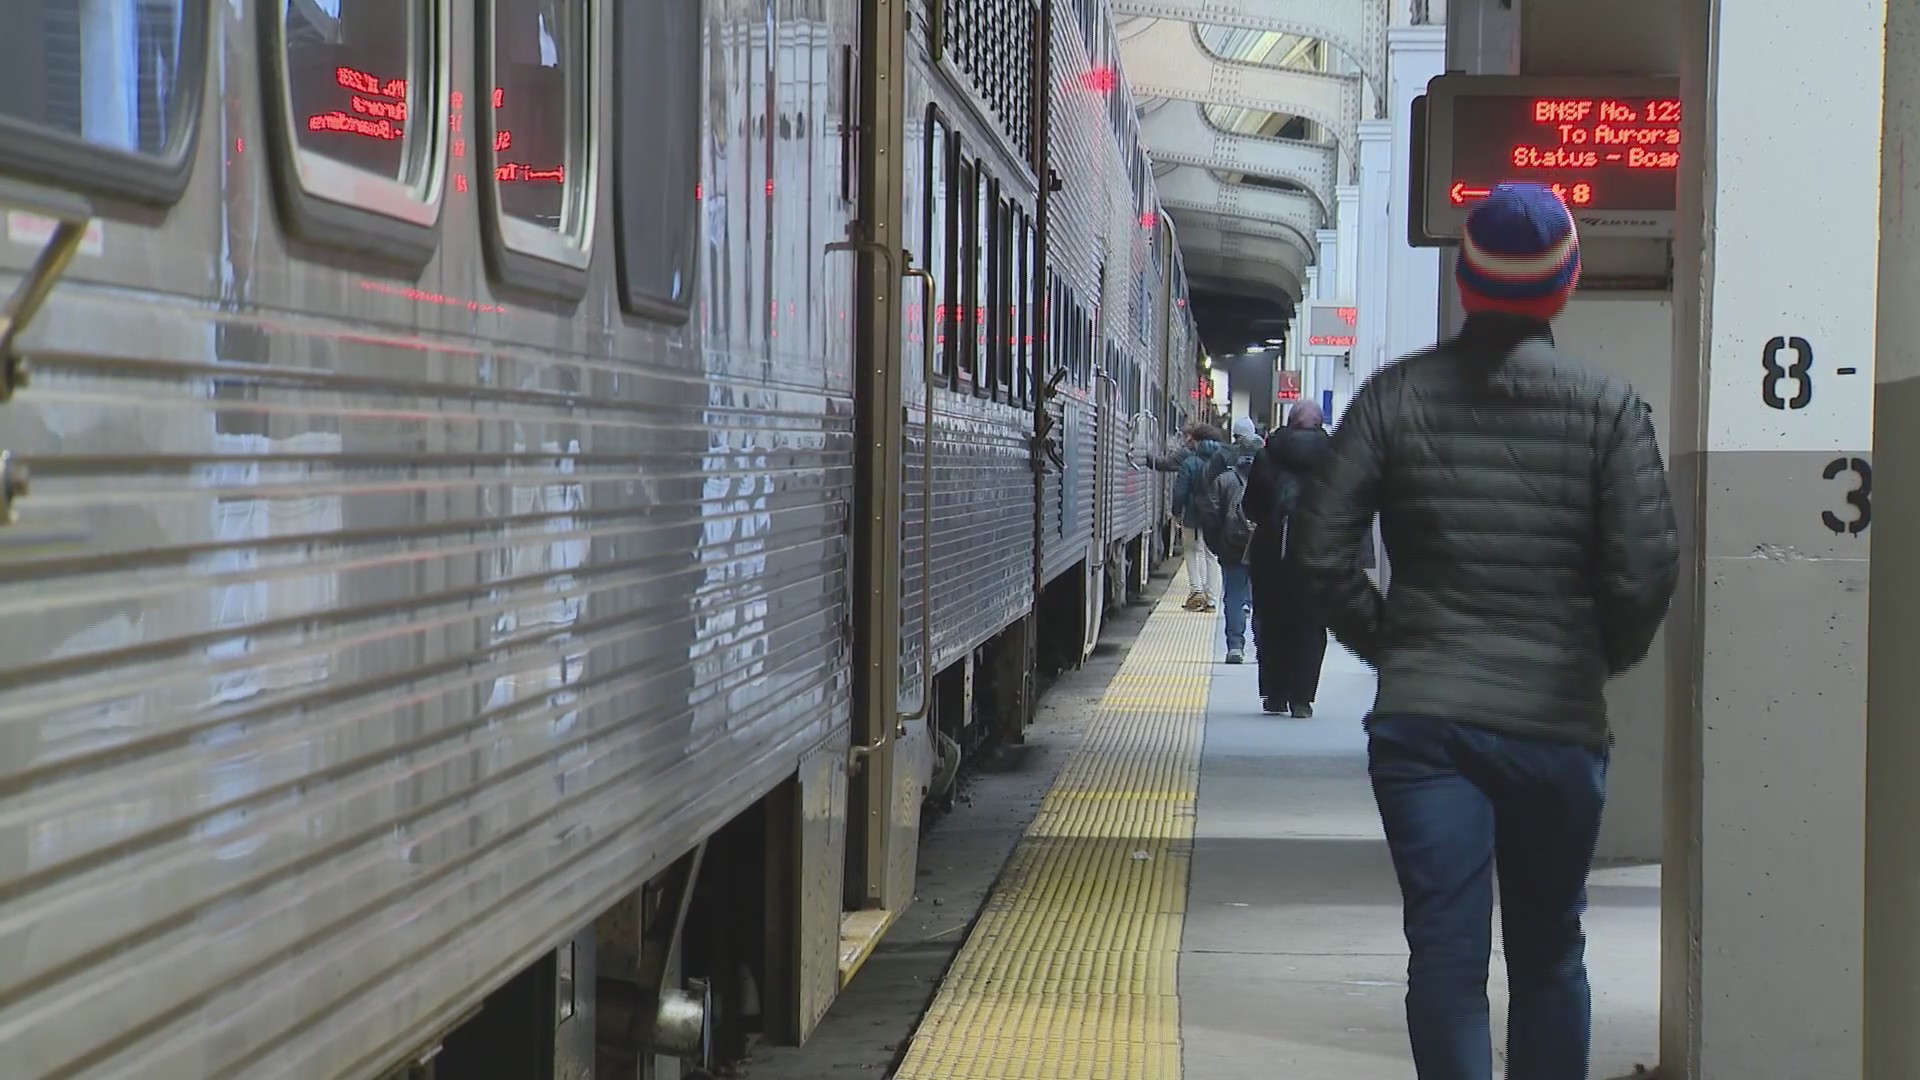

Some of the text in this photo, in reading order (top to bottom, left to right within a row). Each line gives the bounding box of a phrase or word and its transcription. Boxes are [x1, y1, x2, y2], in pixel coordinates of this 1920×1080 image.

[1535, 100, 1593, 122] BNSF
[1600, 99, 1636, 122] No.
[1558, 123, 1681, 145] To Aurora
[1513, 146, 1599, 168] Status
[1573, 183, 1591, 205] 8
[1762, 336, 1813, 410] 8
[1822, 457, 1873, 535] 3
